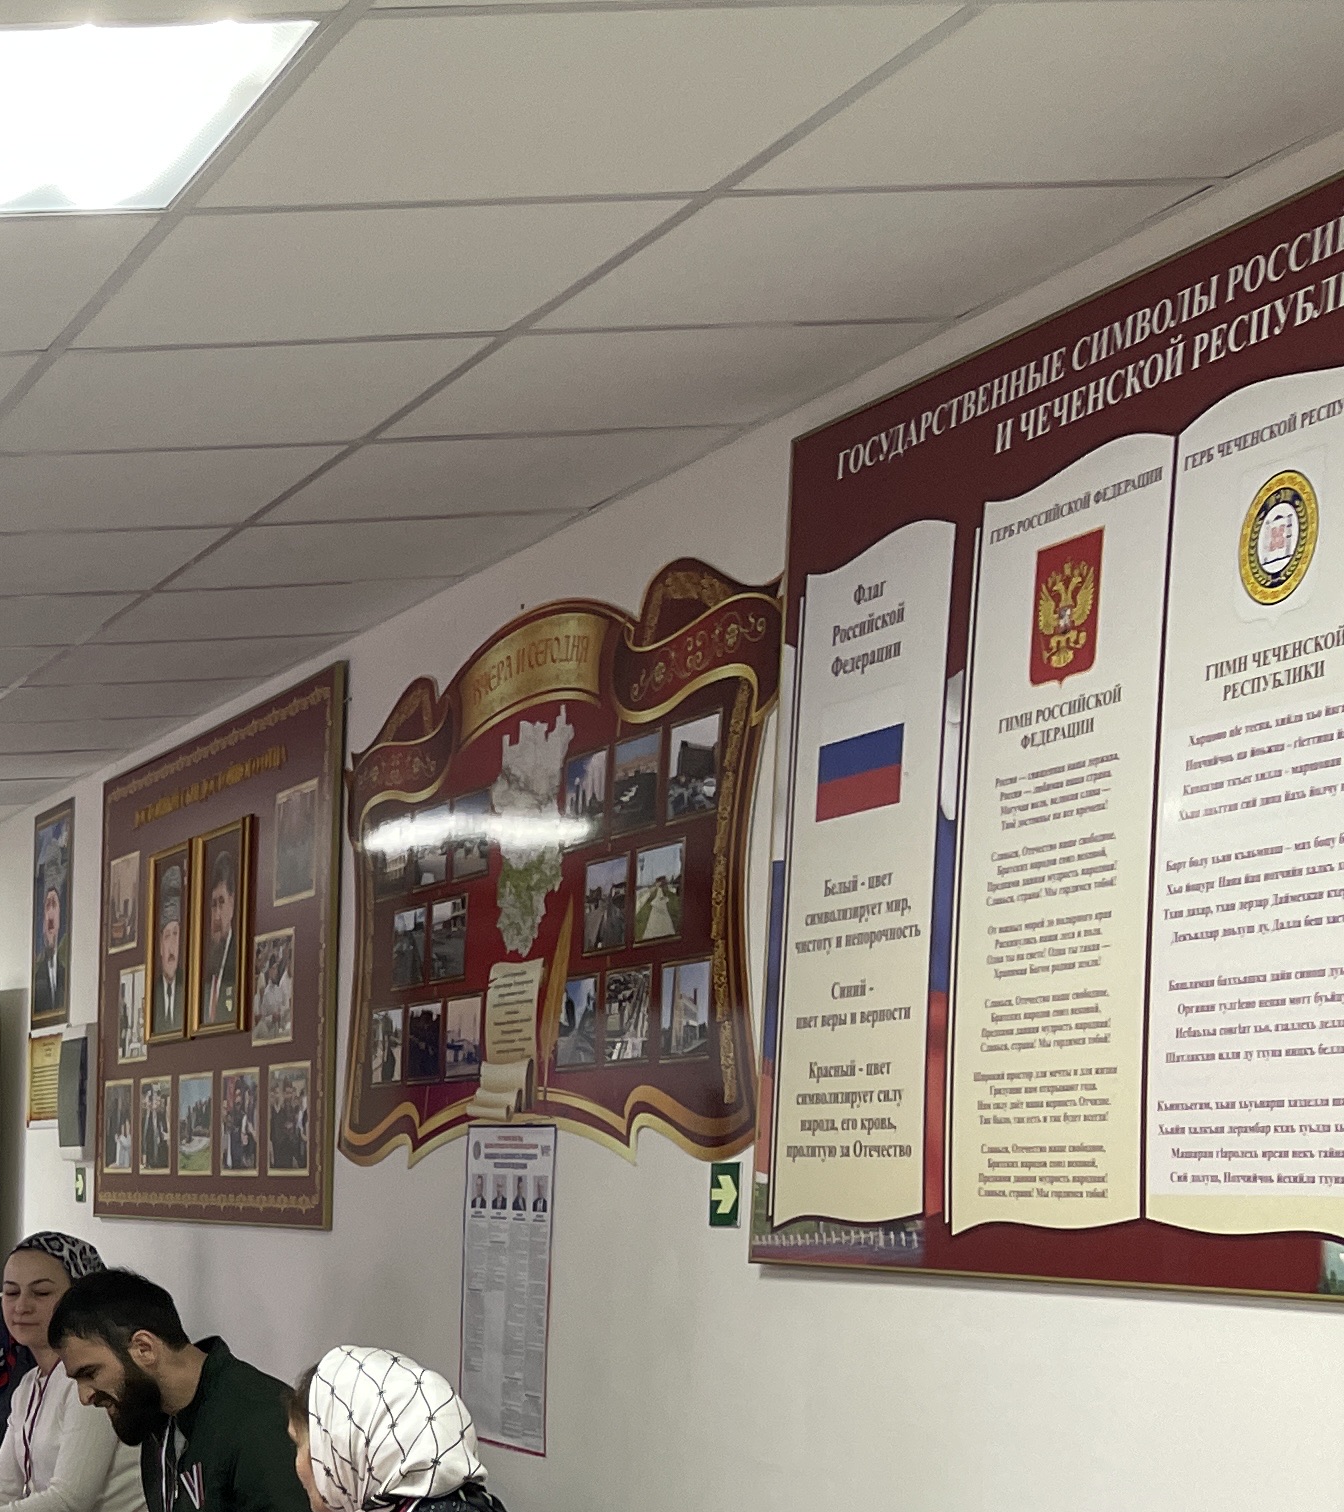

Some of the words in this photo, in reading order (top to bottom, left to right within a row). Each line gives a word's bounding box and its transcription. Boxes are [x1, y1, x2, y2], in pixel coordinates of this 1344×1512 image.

[836, 347, 1067, 481] ГОСУДАРСТВЕННЫЕ
[1072, 274, 1221, 371] СИМВОЛЫ
[994, 418, 1014, 455] И
[1019, 333, 1186, 441] ЧЕЧЕНСКОЙ
[1184, 449, 1214, 472] ГЕРБ
[1217, 412, 1297, 460] ЧЕЧЕНСКОЙ
[989, 526, 1015, 545] ГЕРБ
[1016, 490, 1092, 536] РОССИЙСКОЙ
[1093, 466, 1163, 504] ФЕДЕРАЦИИ
[853, 580, 887, 605] Флаг
[832, 601, 905, 647] Российской
[831, 641, 902, 677] Федерации
[1205, 654, 1248, 682] ГИМН
[1252, 625, 1344, 669] ЧЕЧЕНСКОЙ
[1223, 659, 1326, 702] РЕСПУБЛИКИ
[998, 711, 1033, 734] ГИМН
[1035, 683, 1122, 724] РОССИЙСКОЙ
[1020, 717, 1095, 749] ФЕДЕРАЦИИ
[823, 874, 859, 897] Белый
[867, 872, 893, 890] цвет
[805, 902, 883, 926] символизирует
[795, 937, 833, 956] чистоту
[845, 924, 921, 949] непорочность
[831, 978, 867, 1000] Синий
[796, 1015, 819, 1030] цвет
[820, 1013, 847, 1033] веры
[859, 1006, 912, 1029] верности
[809, 1060, 856, 1083] Красный
[866, 1061, 892, 1076] цвет
[796, 1090, 875, 1109] символизирует
[877, 1088, 904, 1107] силу
[841, 1118, 858, 1131] его
[786, 1145, 837, 1163] пролитую
[839, 1145, 850, 1158] за
[853, 1140, 912, 1158] Отечество
